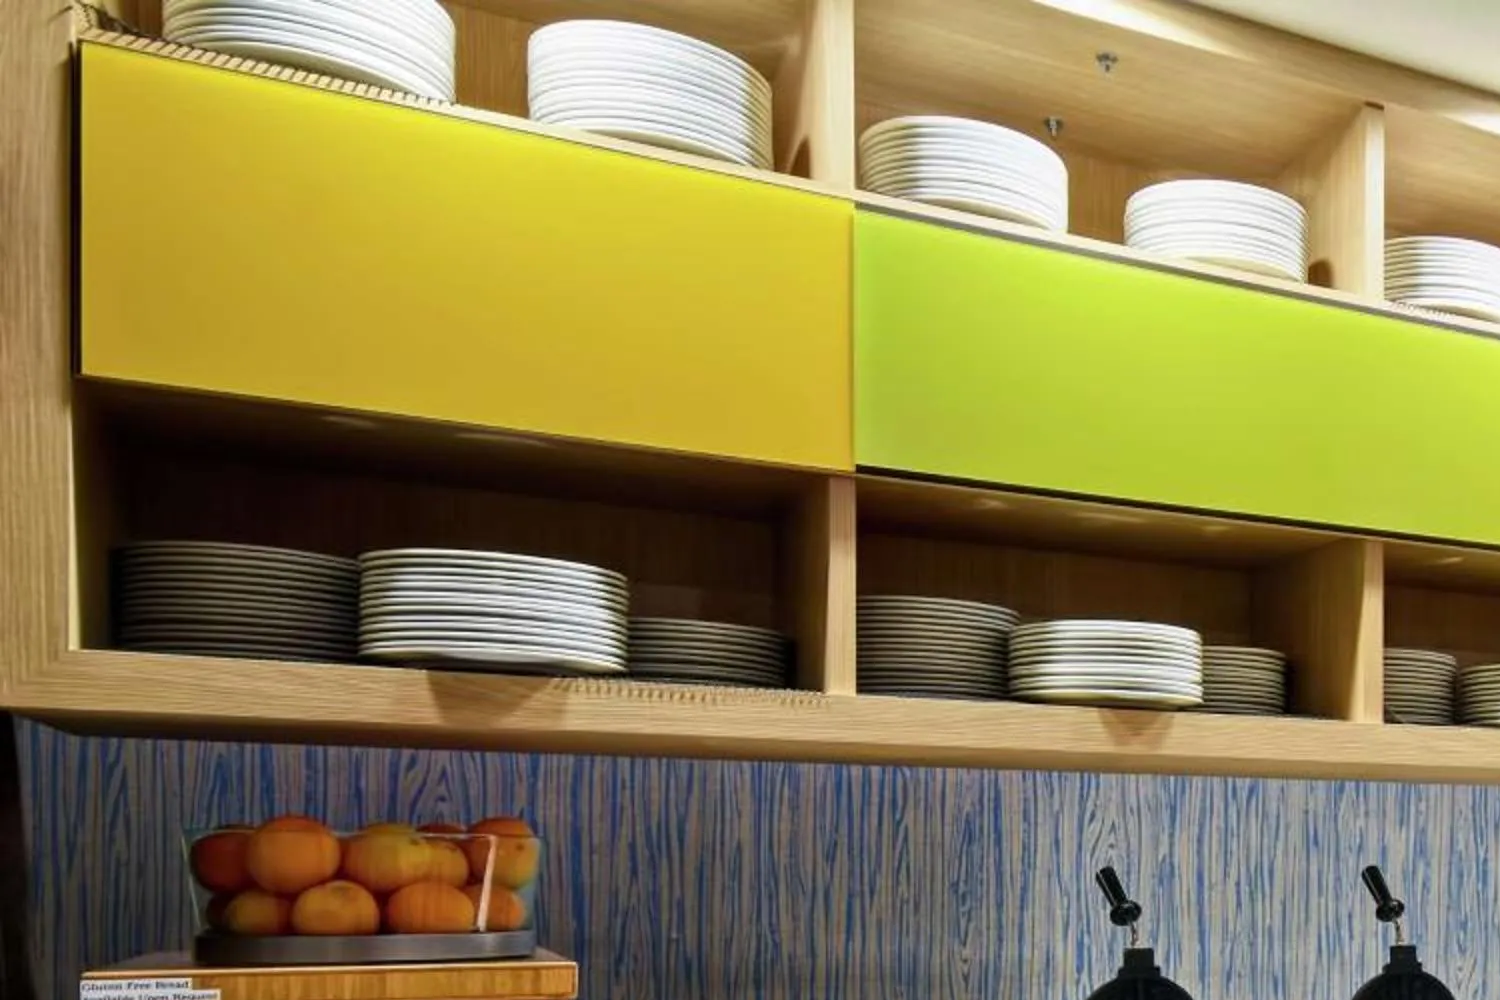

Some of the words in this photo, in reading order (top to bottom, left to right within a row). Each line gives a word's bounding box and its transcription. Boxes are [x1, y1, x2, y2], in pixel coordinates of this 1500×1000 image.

[81, 981, 123, 991] Gluten
[127, 981, 151, 991] Free
[155, 979, 190, 990] Bread
